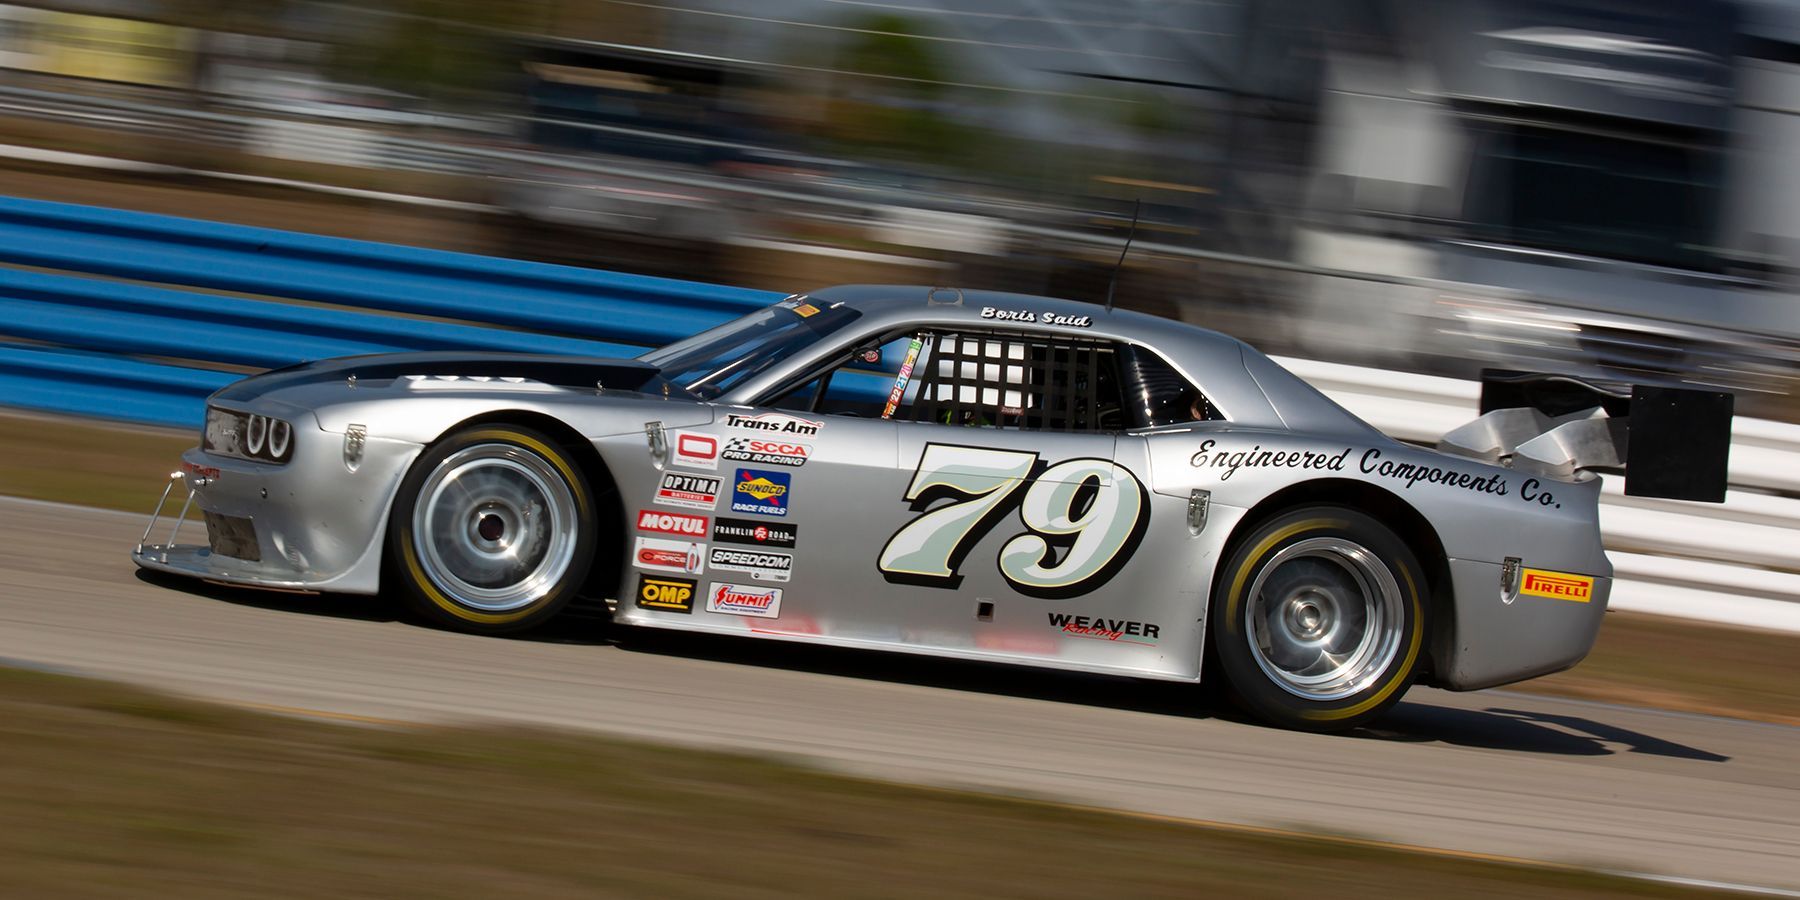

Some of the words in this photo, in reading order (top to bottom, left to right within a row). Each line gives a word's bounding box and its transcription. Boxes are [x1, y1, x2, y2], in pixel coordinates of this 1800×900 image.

[981, 307, 1036, 322] Boris
[1041, 312, 1092, 327] Said
[890, 389, 901, 402] 22
[726, 415, 779, 431] Trans
[782, 421, 818, 435] Am
[750, 439, 807, 456] SCCA
[723, 451, 751, 461] PRO
[752, 453, 804, 466] RACING
[1190, 439, 1351, 481] Engineered
[1360, 449, 1509, 496] Components
[1521, 479, 1562, 509] Co.
[664, 475, 717, 494] OPTIMA
[738, 482, 785, 495] SUNOCO
[671, 491, 705, 501] BATTERIES
[733, 503, 758, 512] RACE
[758, 505, 786, 515] FUELS
[640, 513, 705, 534] MOTUL
[877, 441, 1151, 600] 79
[715, 525, 753, 537] FRANKLIN
[642, 584, 691, 604] OMP
[1525, 574, 1589, 598] PIRELLI
[1048, 612, 1160, 639] WEAVER
[1062, 623, 1124, 641] Racing
